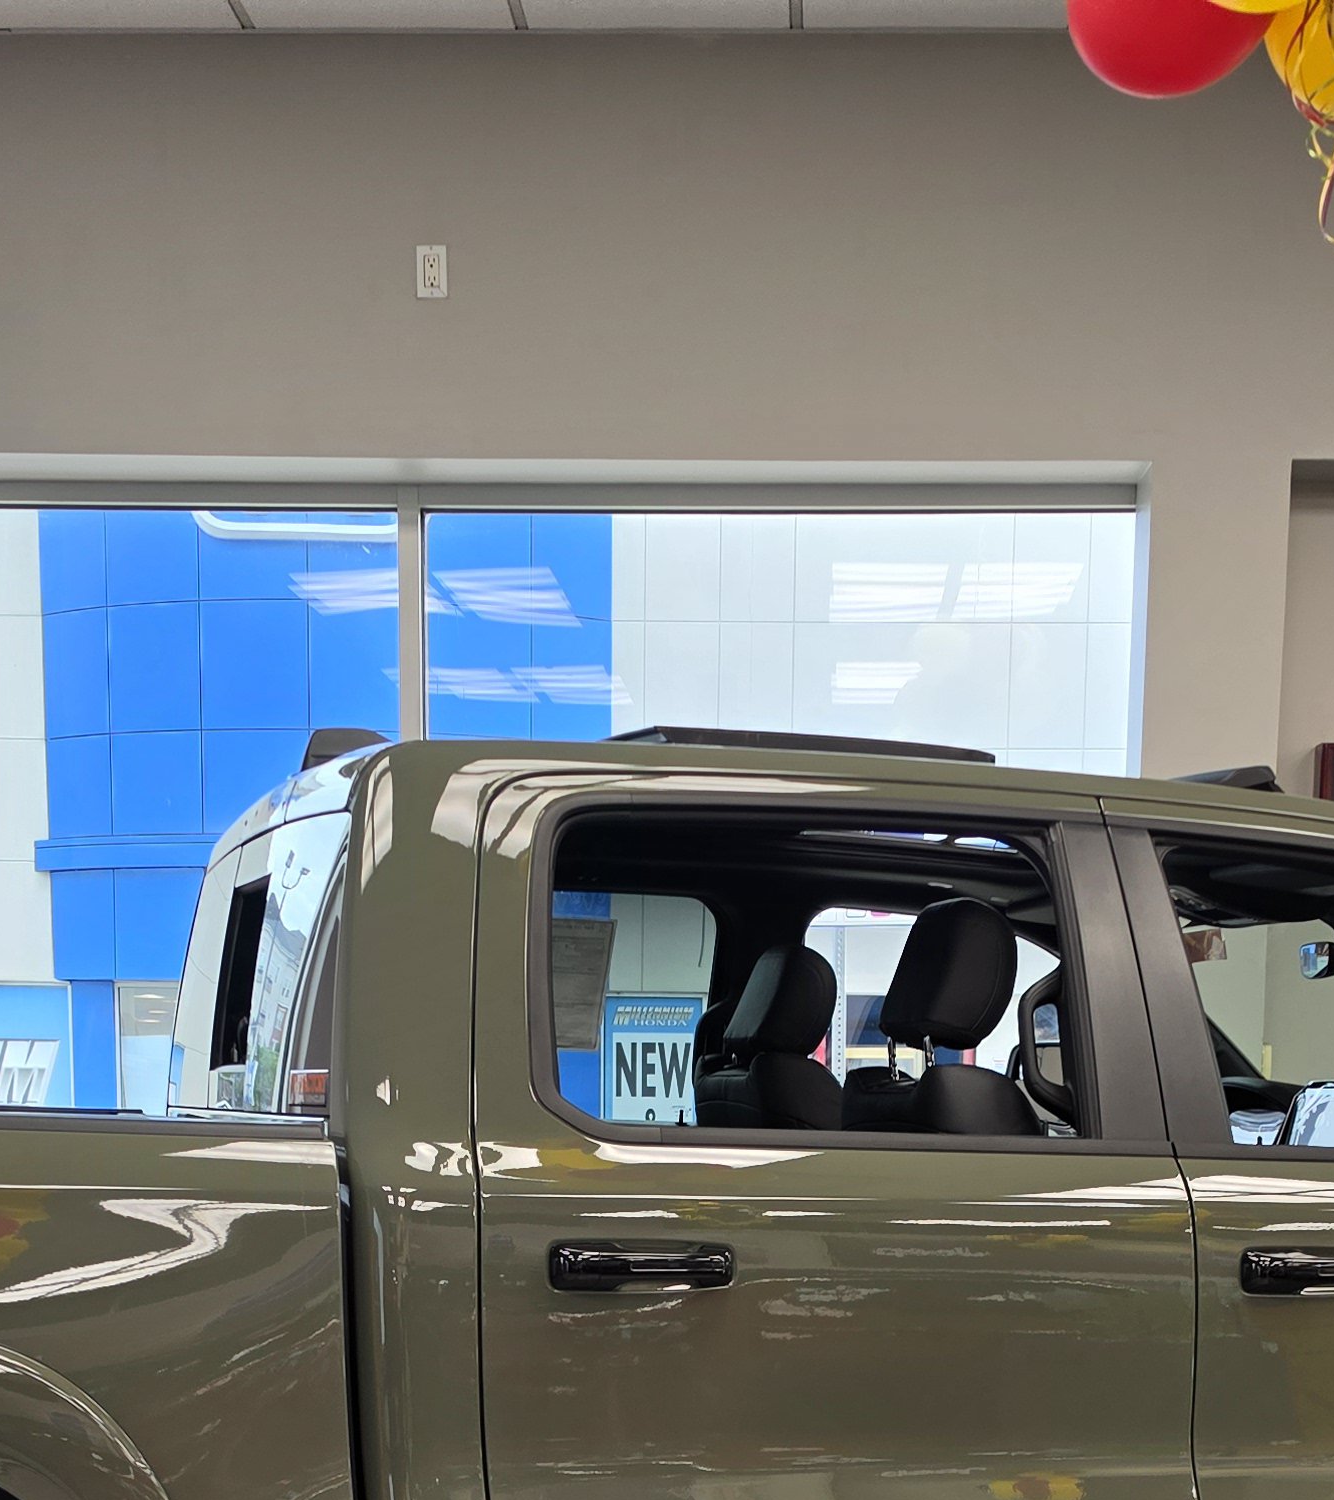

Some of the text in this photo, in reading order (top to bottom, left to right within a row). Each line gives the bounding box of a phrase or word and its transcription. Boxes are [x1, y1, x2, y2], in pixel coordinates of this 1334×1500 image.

[613, 1005, 695, 1026] MILLENNIUM
[633, 1018, 688, 1027] HONDA
[615, 1041, 692, 1099] NEW
